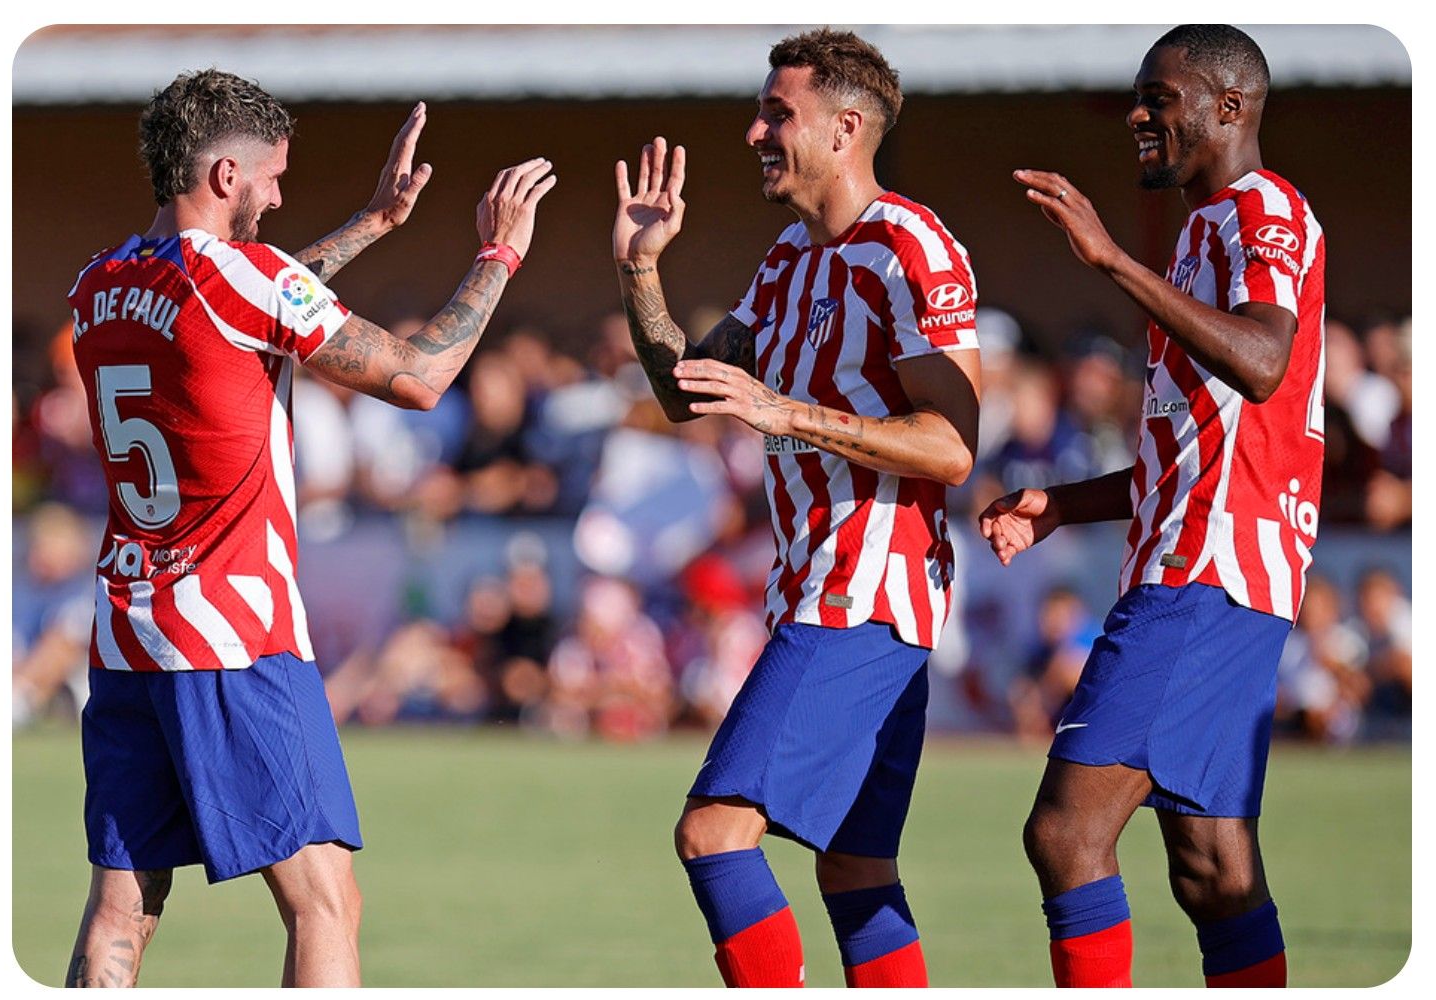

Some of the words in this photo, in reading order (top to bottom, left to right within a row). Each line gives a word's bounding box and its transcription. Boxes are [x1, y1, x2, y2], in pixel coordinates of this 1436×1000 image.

[93, 286, 122, 327] DE
[121, 286, 181, 342] PAUL
[95, 364, 181, 530] 5
